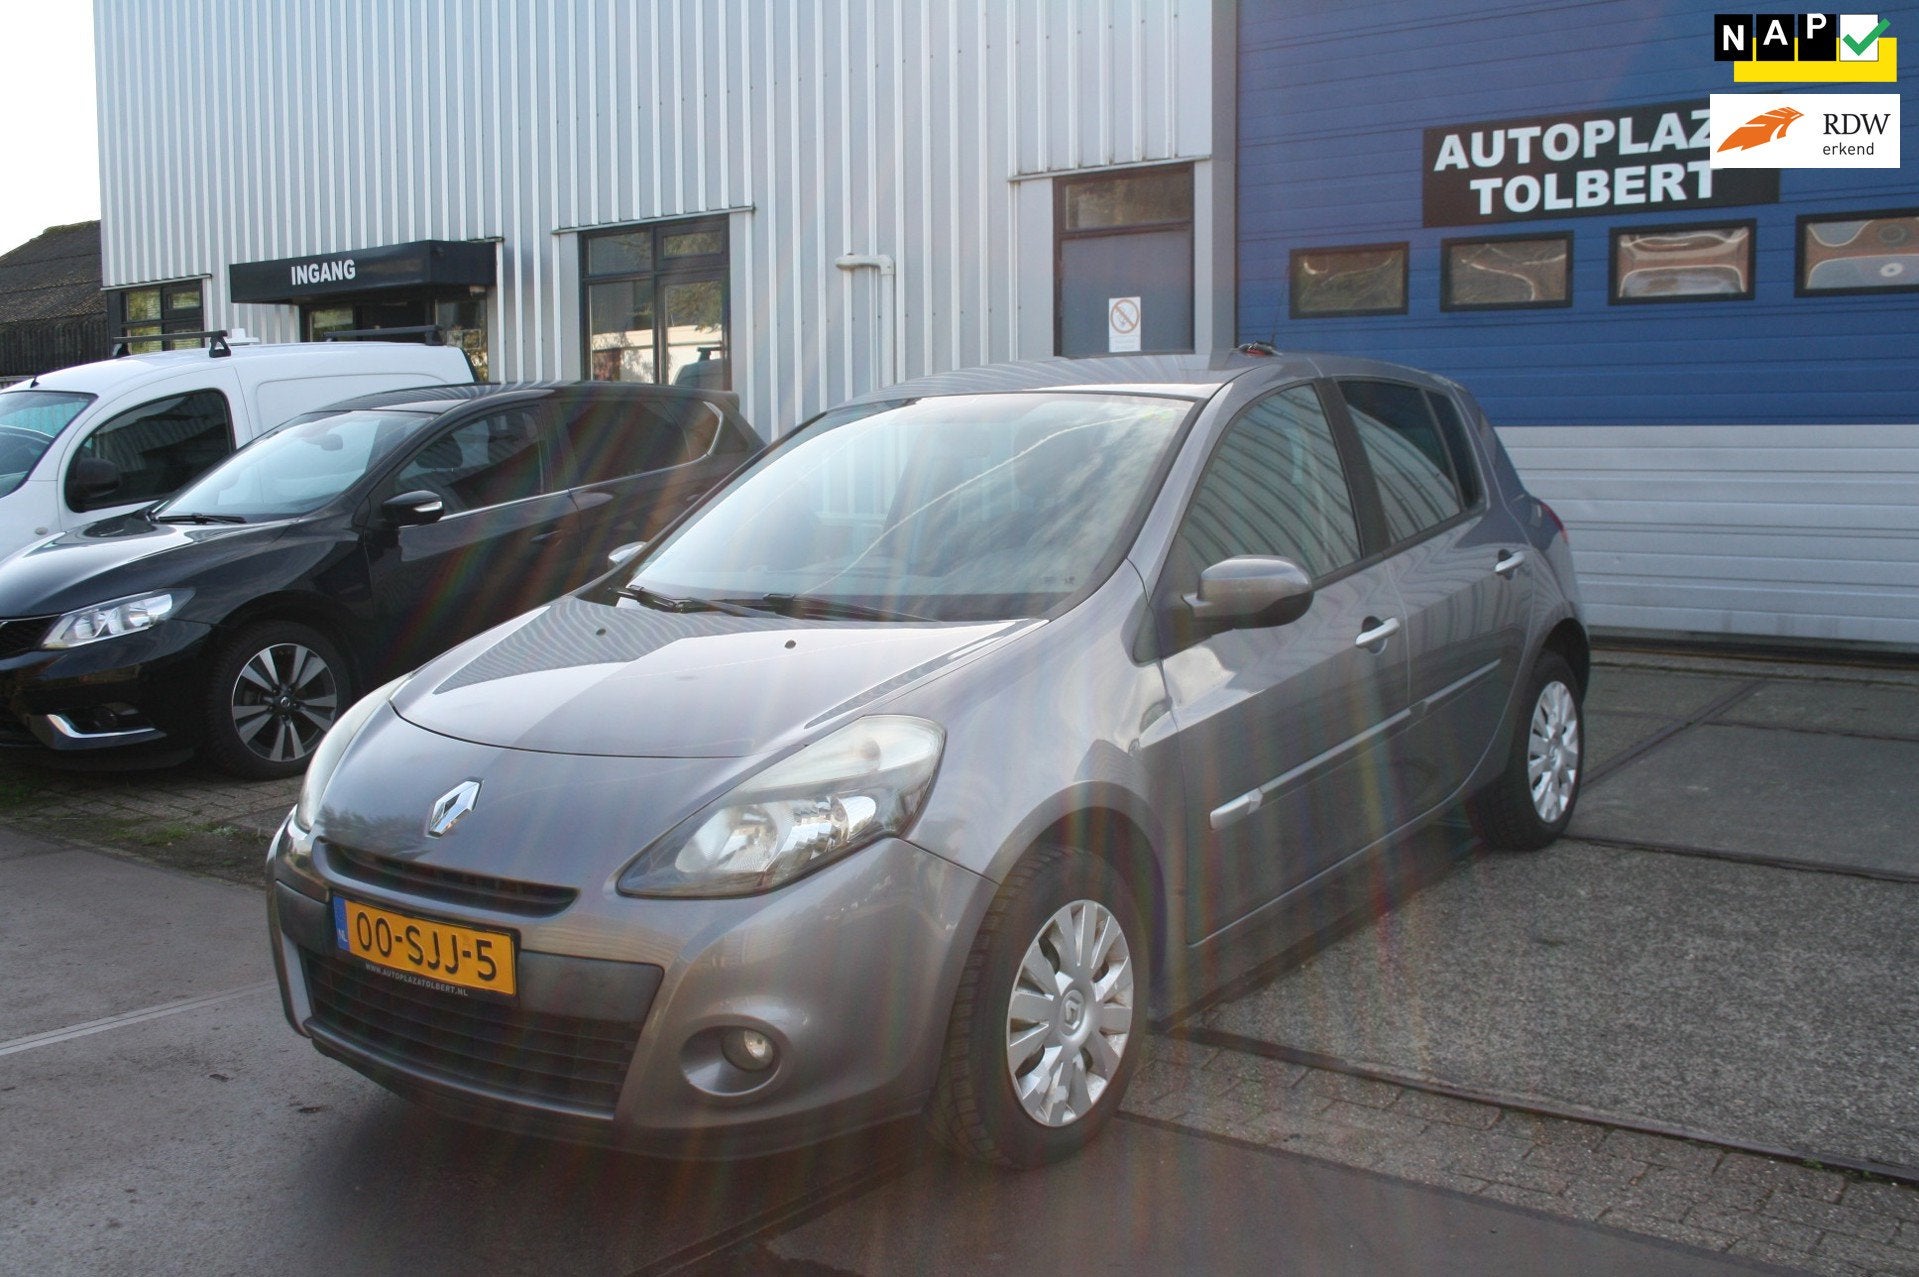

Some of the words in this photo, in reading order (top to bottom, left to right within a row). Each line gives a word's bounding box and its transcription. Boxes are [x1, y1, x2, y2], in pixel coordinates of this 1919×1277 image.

[1434, 109, 1711, 172] AUTOPLAZ
[1470, 160, 1724, 216] TOLBERT
[291, 259, 355, 285] INGANG
[356, 911, 498, 982] 00-SJJ-5
